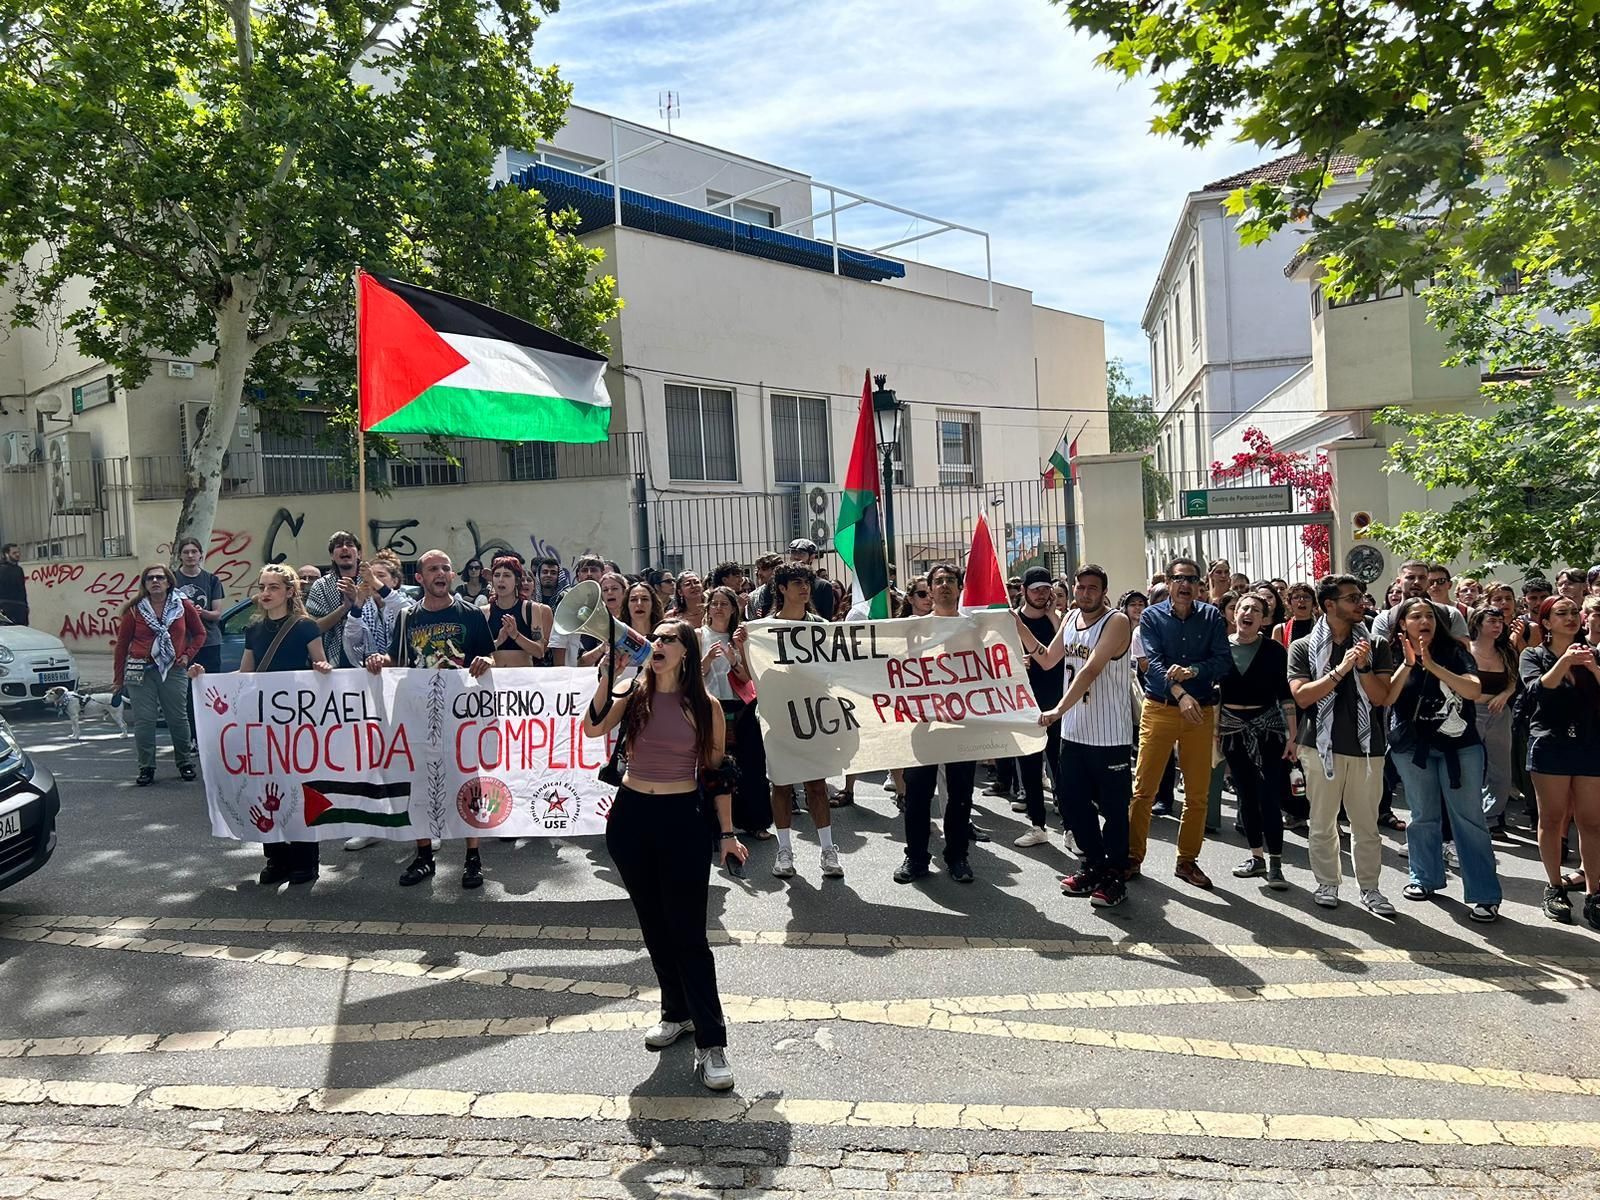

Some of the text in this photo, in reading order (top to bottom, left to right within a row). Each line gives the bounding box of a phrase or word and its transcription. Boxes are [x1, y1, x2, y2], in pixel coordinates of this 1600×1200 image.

[1268, 492, 1283, 500] Activa
[768, 625, 888, 664] ISRAEL
[887, 643, 1013, 689] ASESINA
[257, 690, 382, 727] ISRAEL
[556, 692, 581, 717] UE
[788, 684, 1036, 740] UGR PATROCINA
[220, 723, 415, 776] GENOCIDA
[533, 781, 562, 798] Sindical
[544, 820, 567, 829] USE
